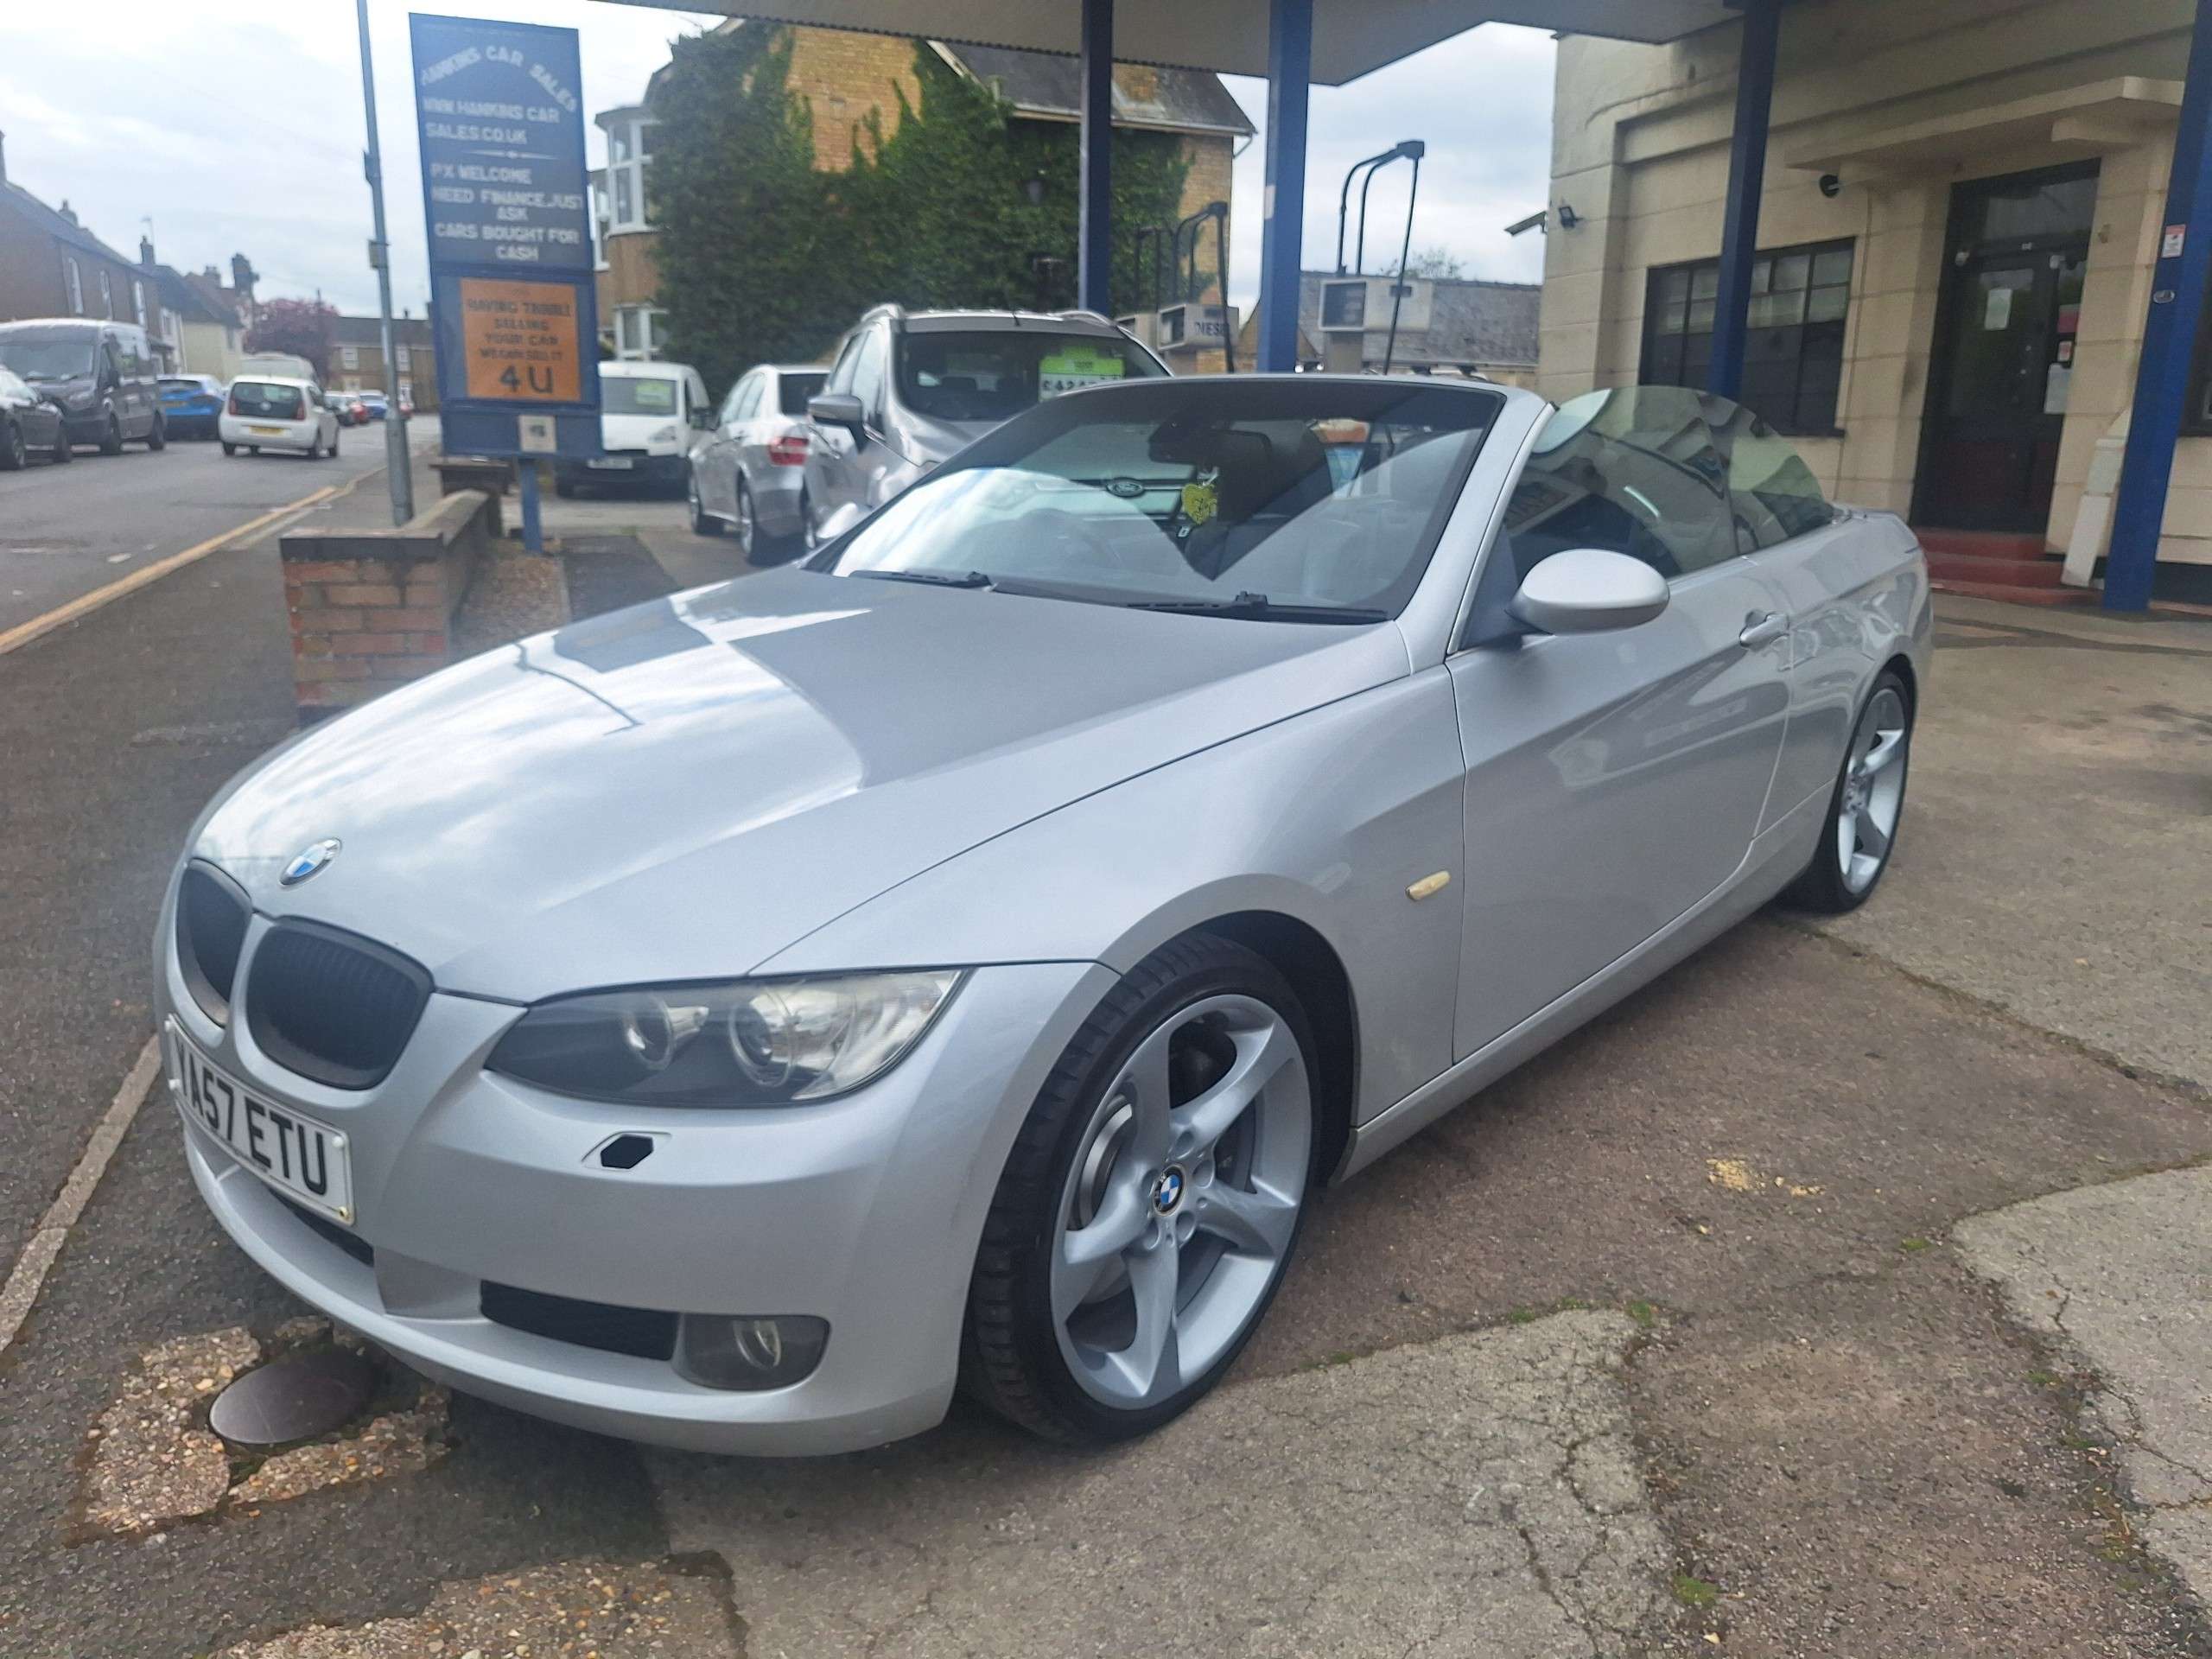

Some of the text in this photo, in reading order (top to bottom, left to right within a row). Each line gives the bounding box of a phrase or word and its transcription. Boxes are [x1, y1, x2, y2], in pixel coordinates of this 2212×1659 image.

[486, 46, 524, 67] CAR
[527, 107, 560, 124] CAR
[458, 165, 533, 185] WELCOME
[497, 207, 529, 222] ASK
[435, 222, 581, 245] CARS BOUGHT FOR
[496, 245, 539, 262] CASH
[499, 365, 554, 393] 4 U
[245, 1096, 327, 1196] ETU
